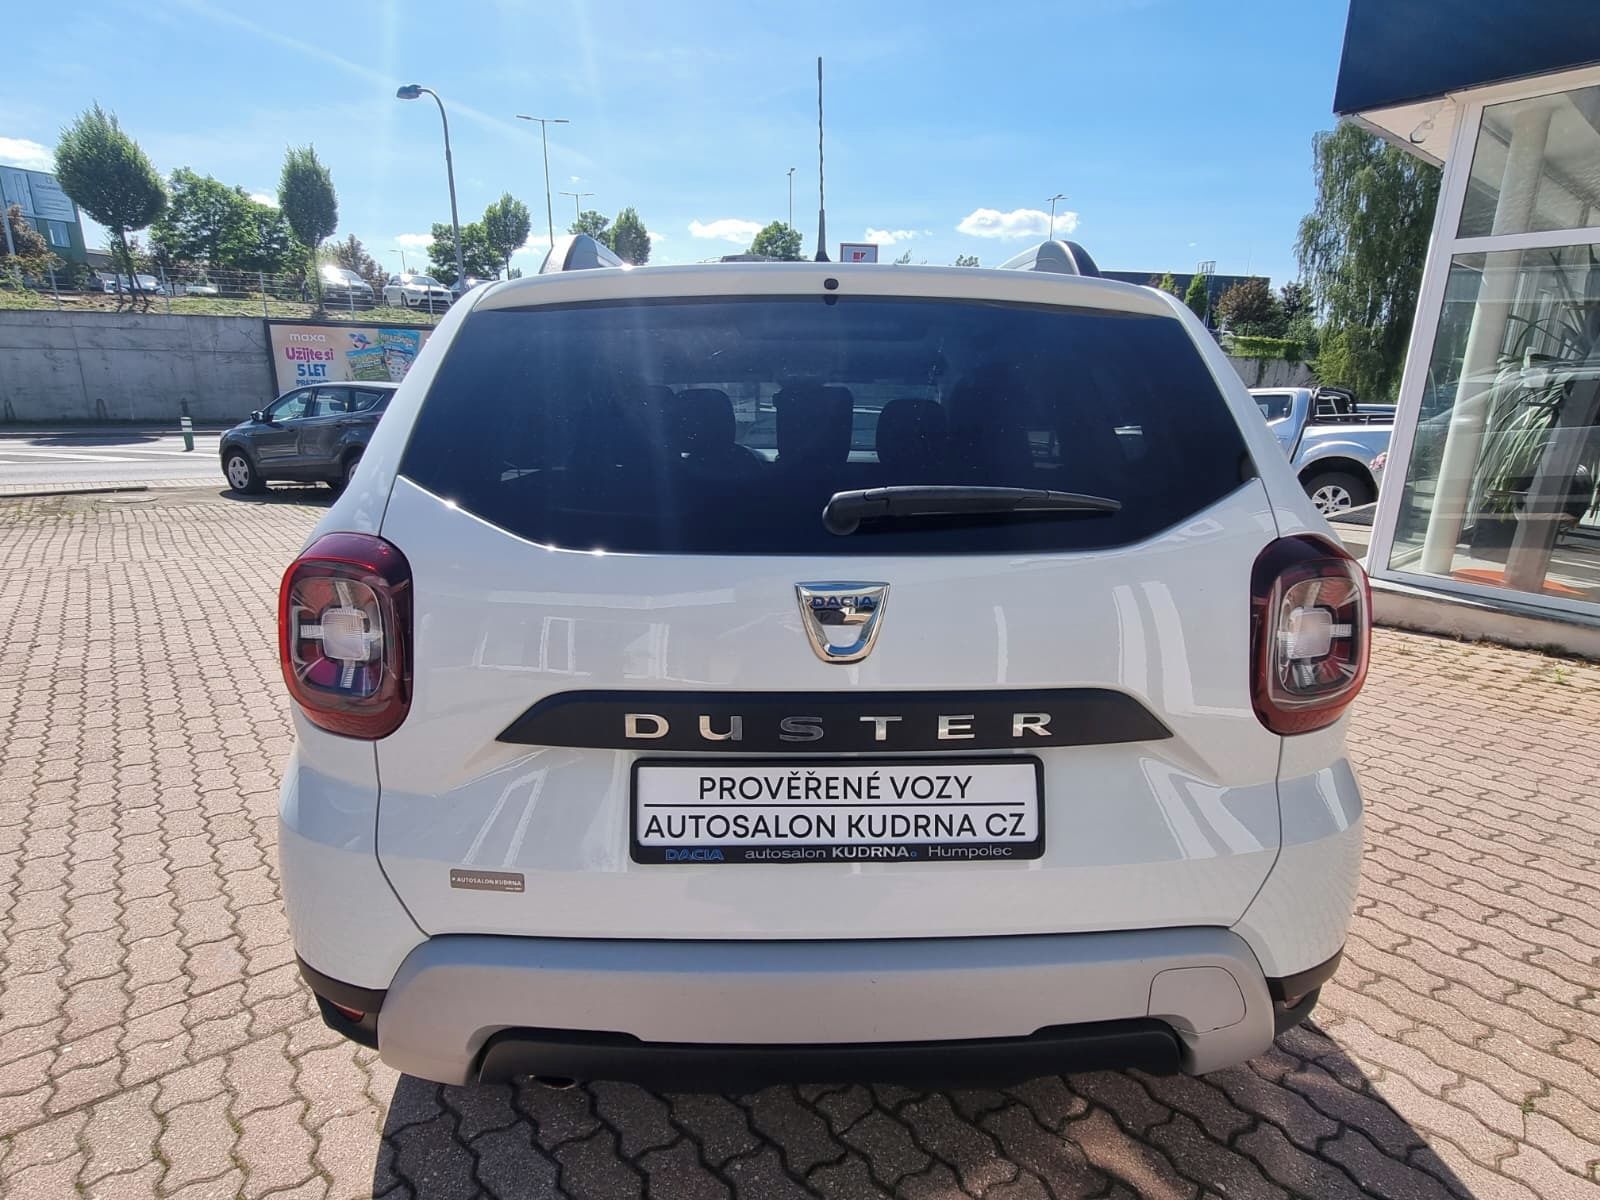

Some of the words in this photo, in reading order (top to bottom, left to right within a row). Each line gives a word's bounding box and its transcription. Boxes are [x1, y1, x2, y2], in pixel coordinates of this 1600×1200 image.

[285, 346, 323, 363] Užijte
[324, 348, 334, 361] si
[297, 363, 306, 377] 5
[307, 363, 327, 377] LET
[812, 596, 873, 608] DACIA
[624, 712, 1053, 742] DUSTER
[699, 770, 880, 801] PROVĚŘENÉ
[889, 775, 973, 800] VOZY
[643, 813, 837, 840] AUTOSALON
[847, 813, 978, 839] KUDRNA
[985, 812, 1027, 837] CZ
[664, 848, 725, 862] DACIA
[744, 847, 827, 860] autosalon
[831, 845, 910, 858] KUDRNA
[928, 844, 1013, 860] Humpolec
